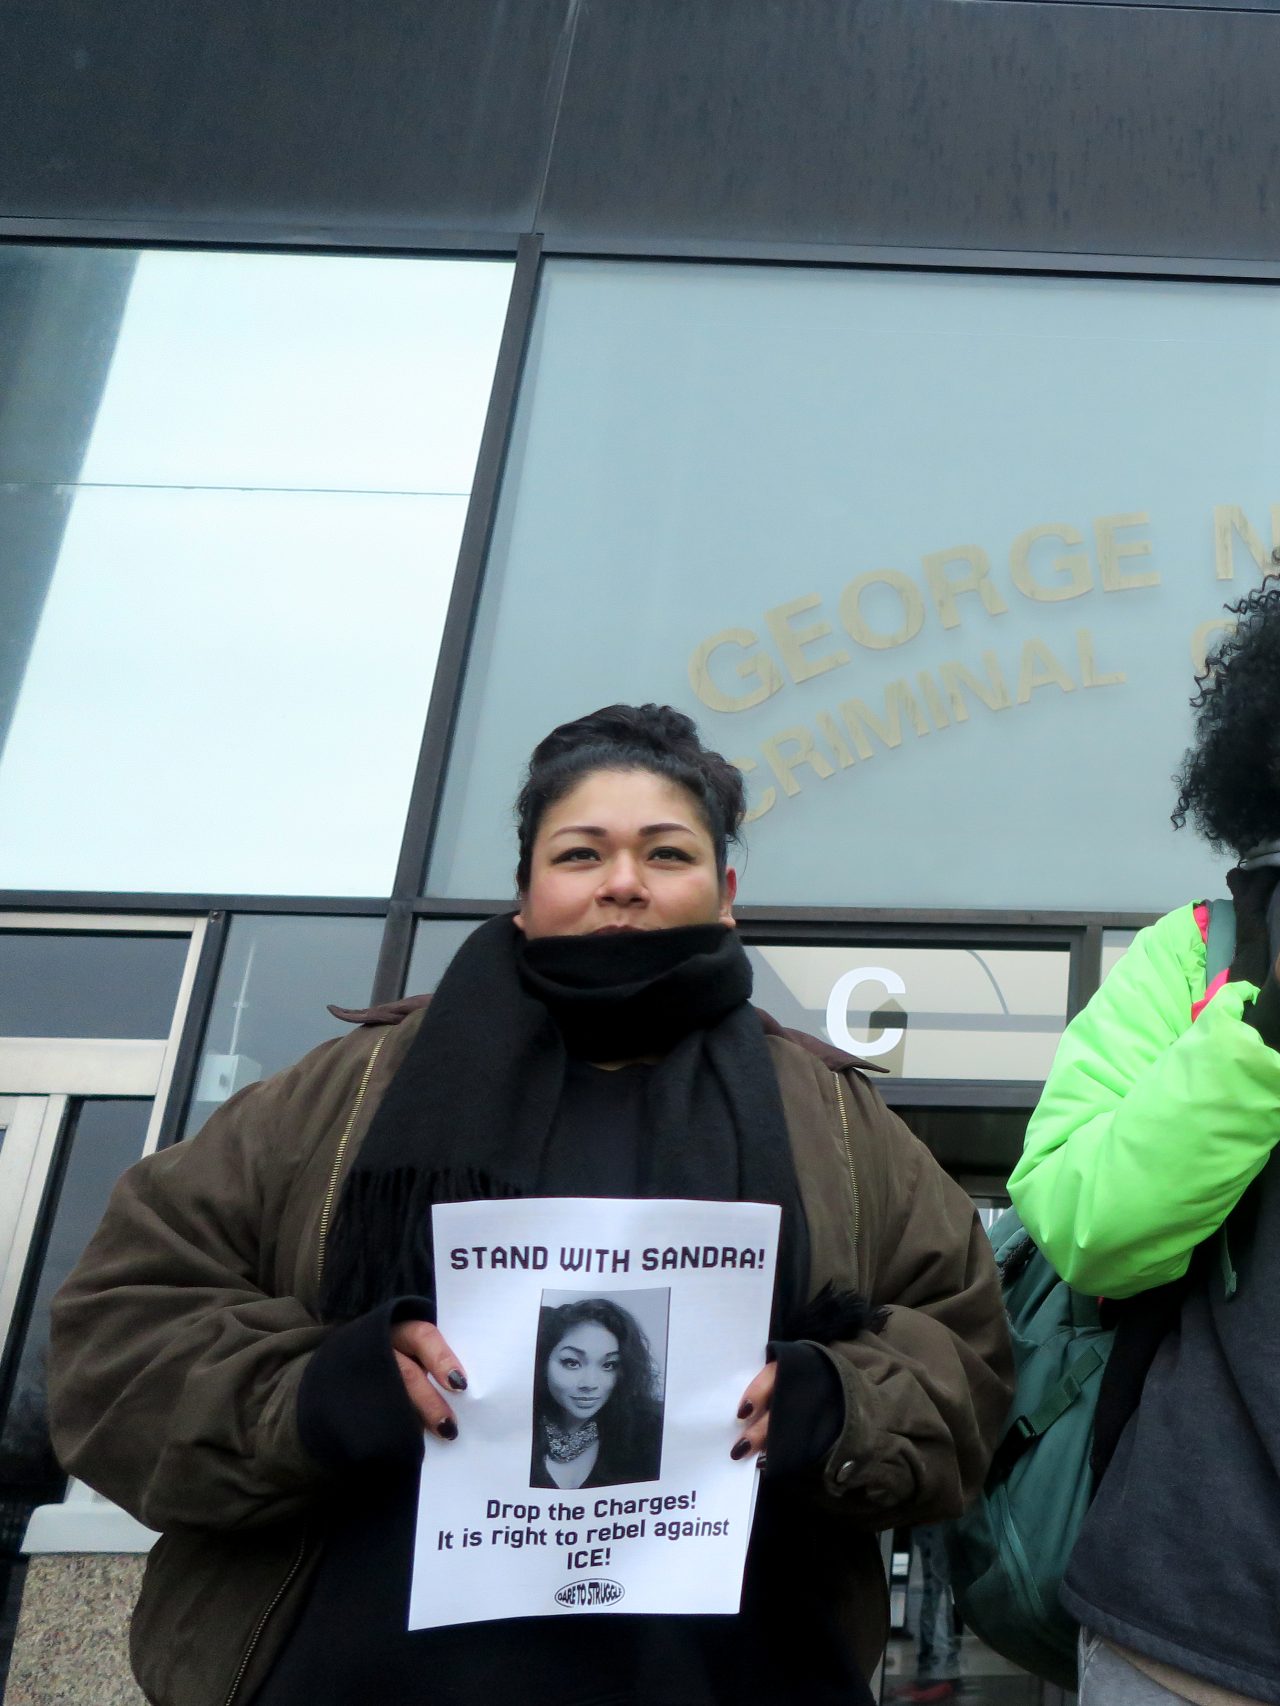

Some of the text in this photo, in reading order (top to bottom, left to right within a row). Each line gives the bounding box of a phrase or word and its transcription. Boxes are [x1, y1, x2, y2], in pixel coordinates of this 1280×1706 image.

[688, 511, 1160, 714] GEORGE
[826, 967, 906, 1057] C
[450, 1246, 764, 1273] STAND WITH SANDRA!
[487, 1490, 696, 1523] Drop the Charges!
[438, 1517, 729, 1550] It is right to rebel against
[568, 1548, 610, 1569] ICE!
[557, 1582, 622, 1606] DARE TO STRUGGLE
